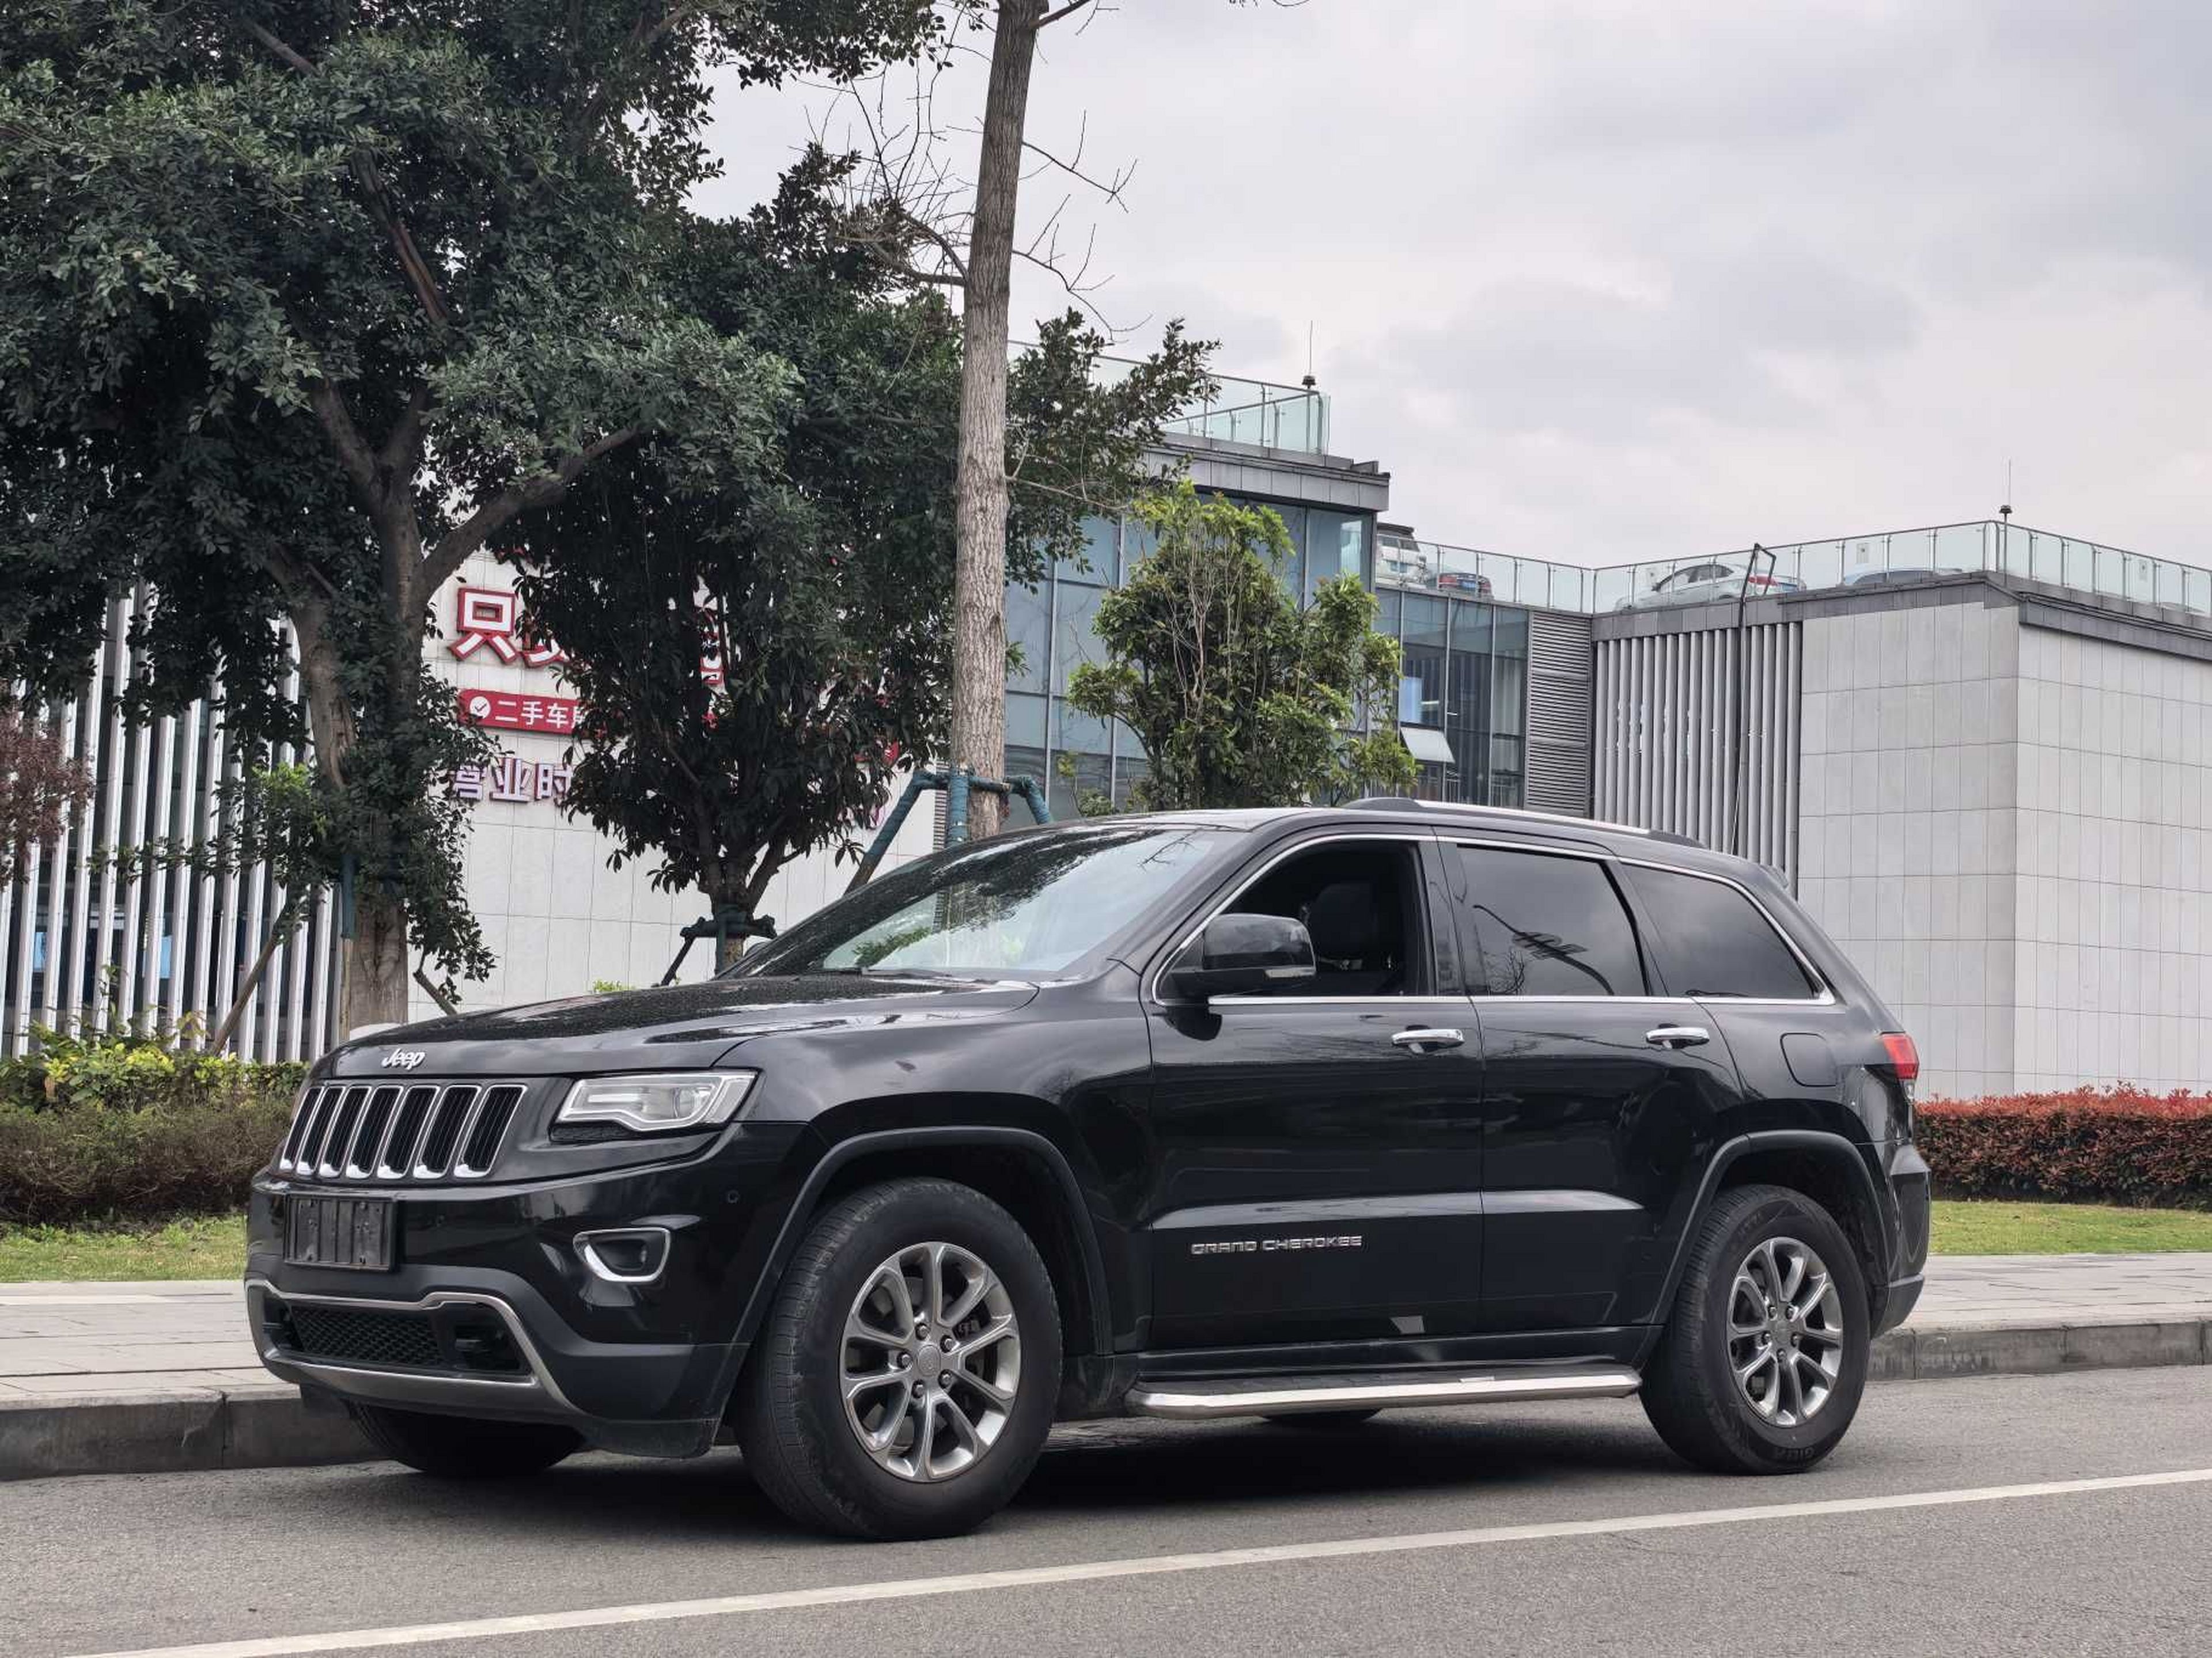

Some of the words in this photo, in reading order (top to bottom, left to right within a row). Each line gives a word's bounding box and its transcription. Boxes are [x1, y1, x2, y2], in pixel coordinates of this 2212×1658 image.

[381, 1048, 426, 1071] Jeep
[1191, 1241, 1257, 1254] GRAND
[1262, 1236, 1362, 1250] CHEROKEE
